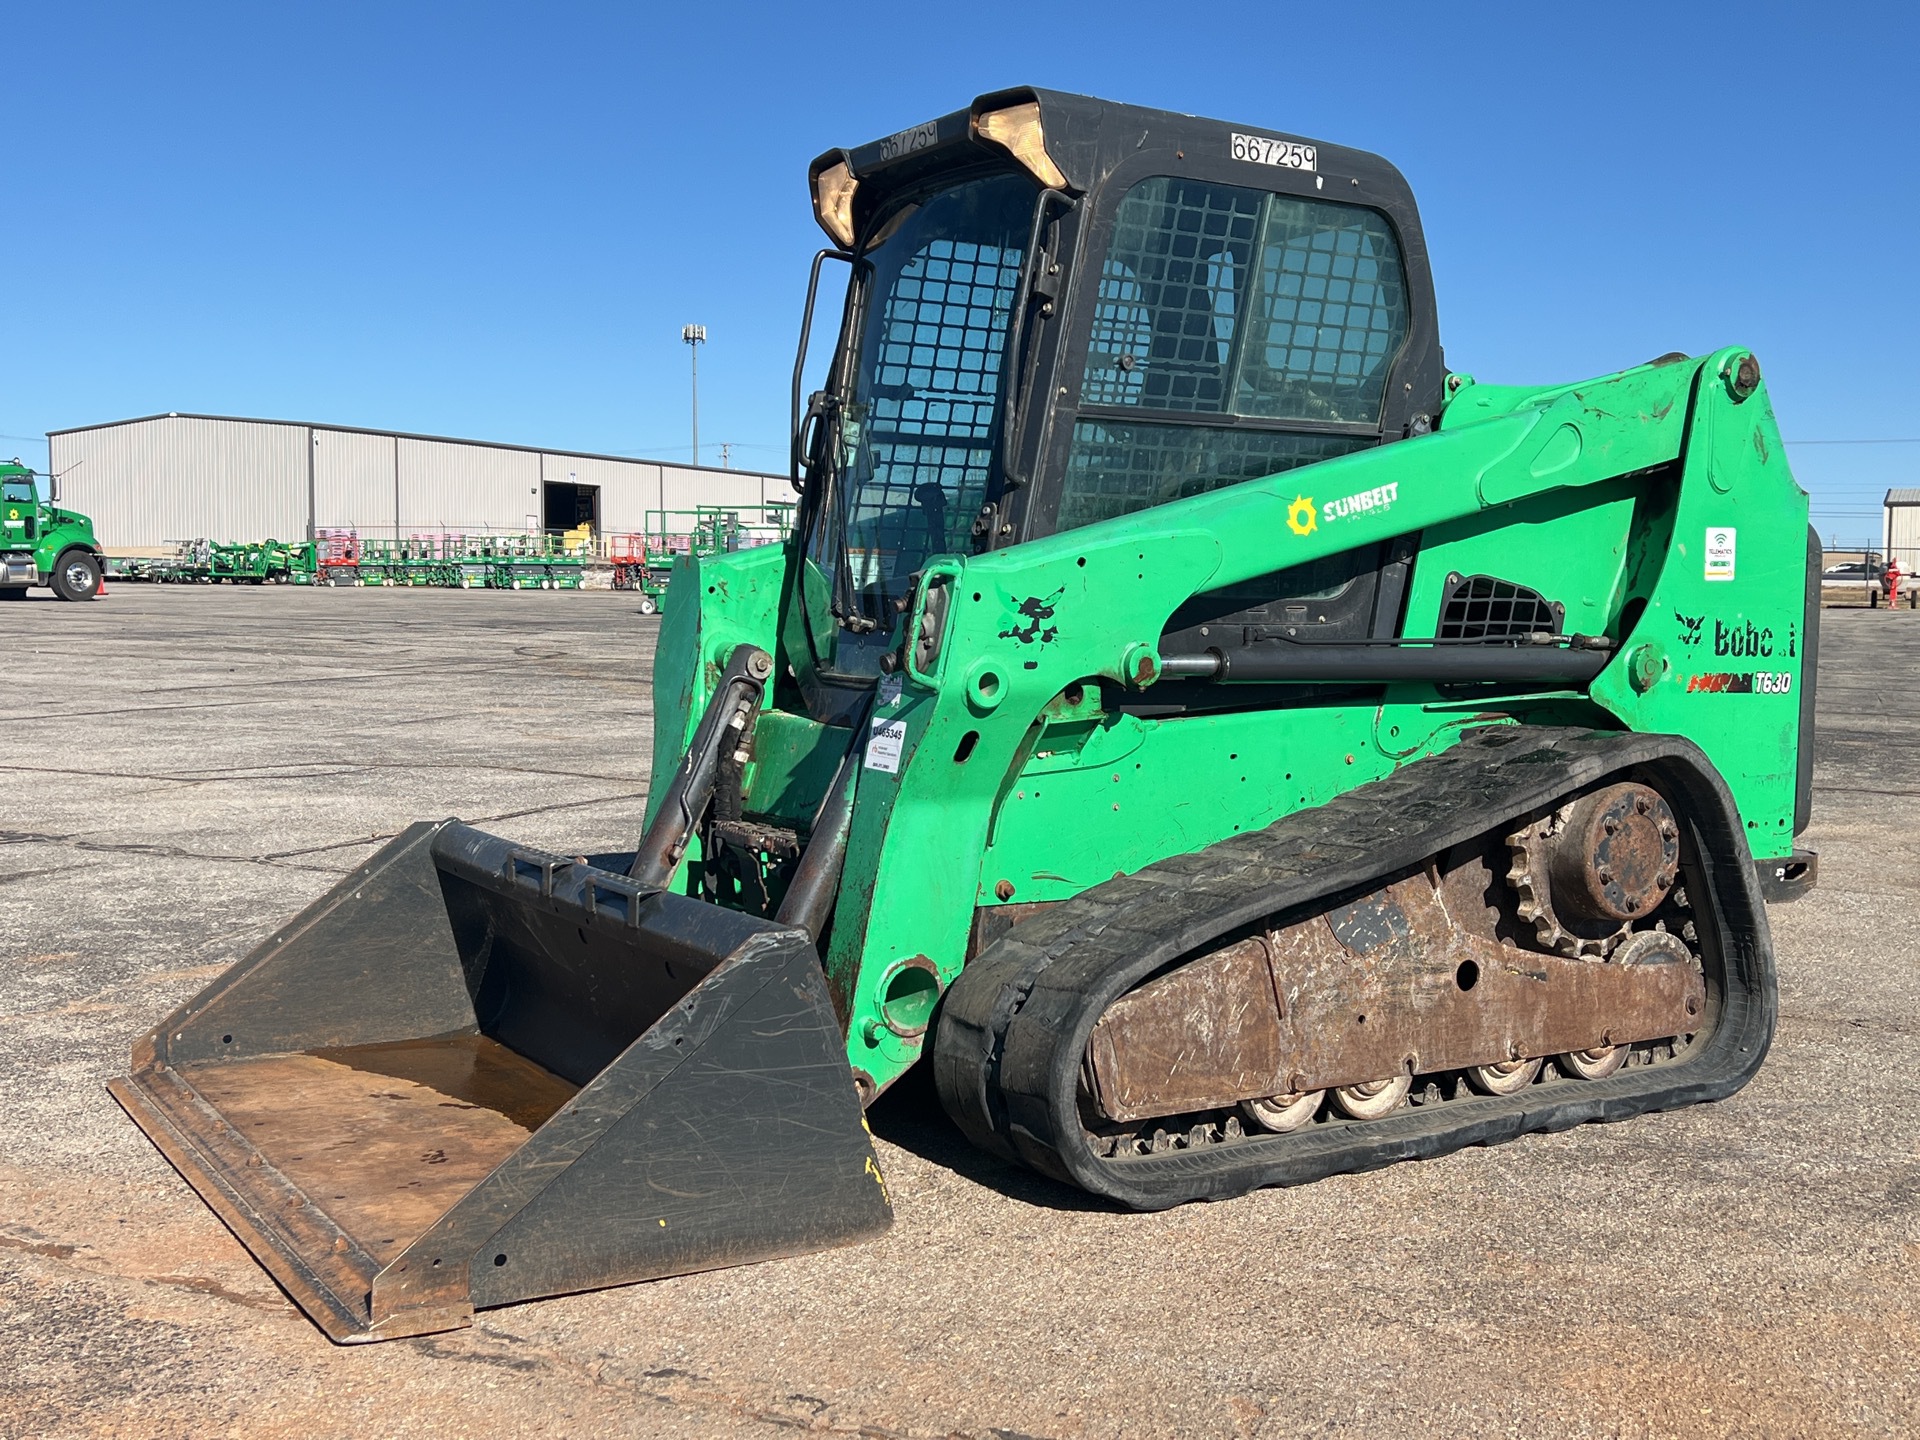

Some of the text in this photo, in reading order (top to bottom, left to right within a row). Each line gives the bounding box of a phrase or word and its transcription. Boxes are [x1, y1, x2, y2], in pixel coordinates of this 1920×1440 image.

[1233, 135, 1316, 171] 667259
[1323, 482, 1398, 522] SUNBELT
[1756, 672, 1792, 693] T630
